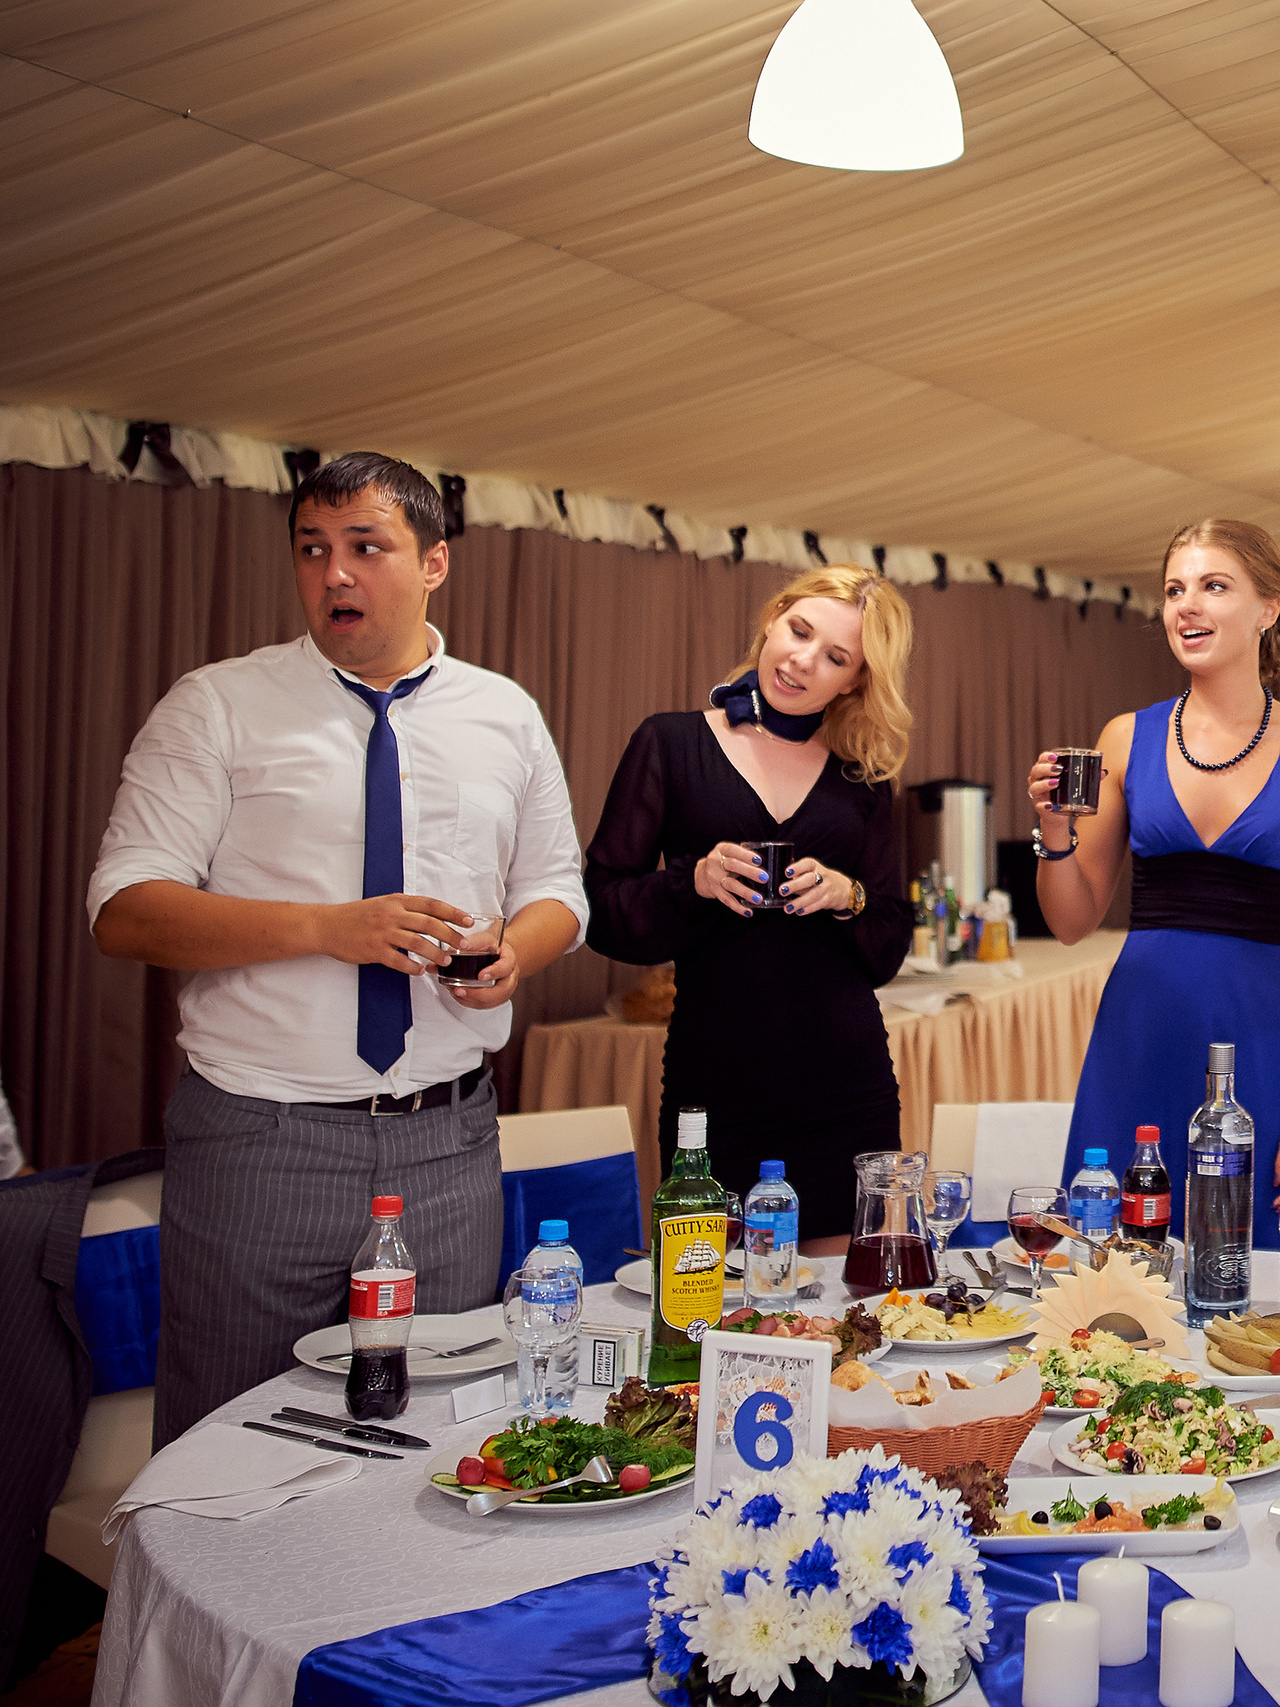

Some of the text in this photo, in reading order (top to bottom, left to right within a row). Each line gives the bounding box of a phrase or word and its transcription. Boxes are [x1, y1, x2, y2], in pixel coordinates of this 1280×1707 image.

[665, 1220, 704, 1237] CUTTY
[604, 1345, 612, 1382] УБИВАЕТ
[733, 1390, 794, 1472] 6
